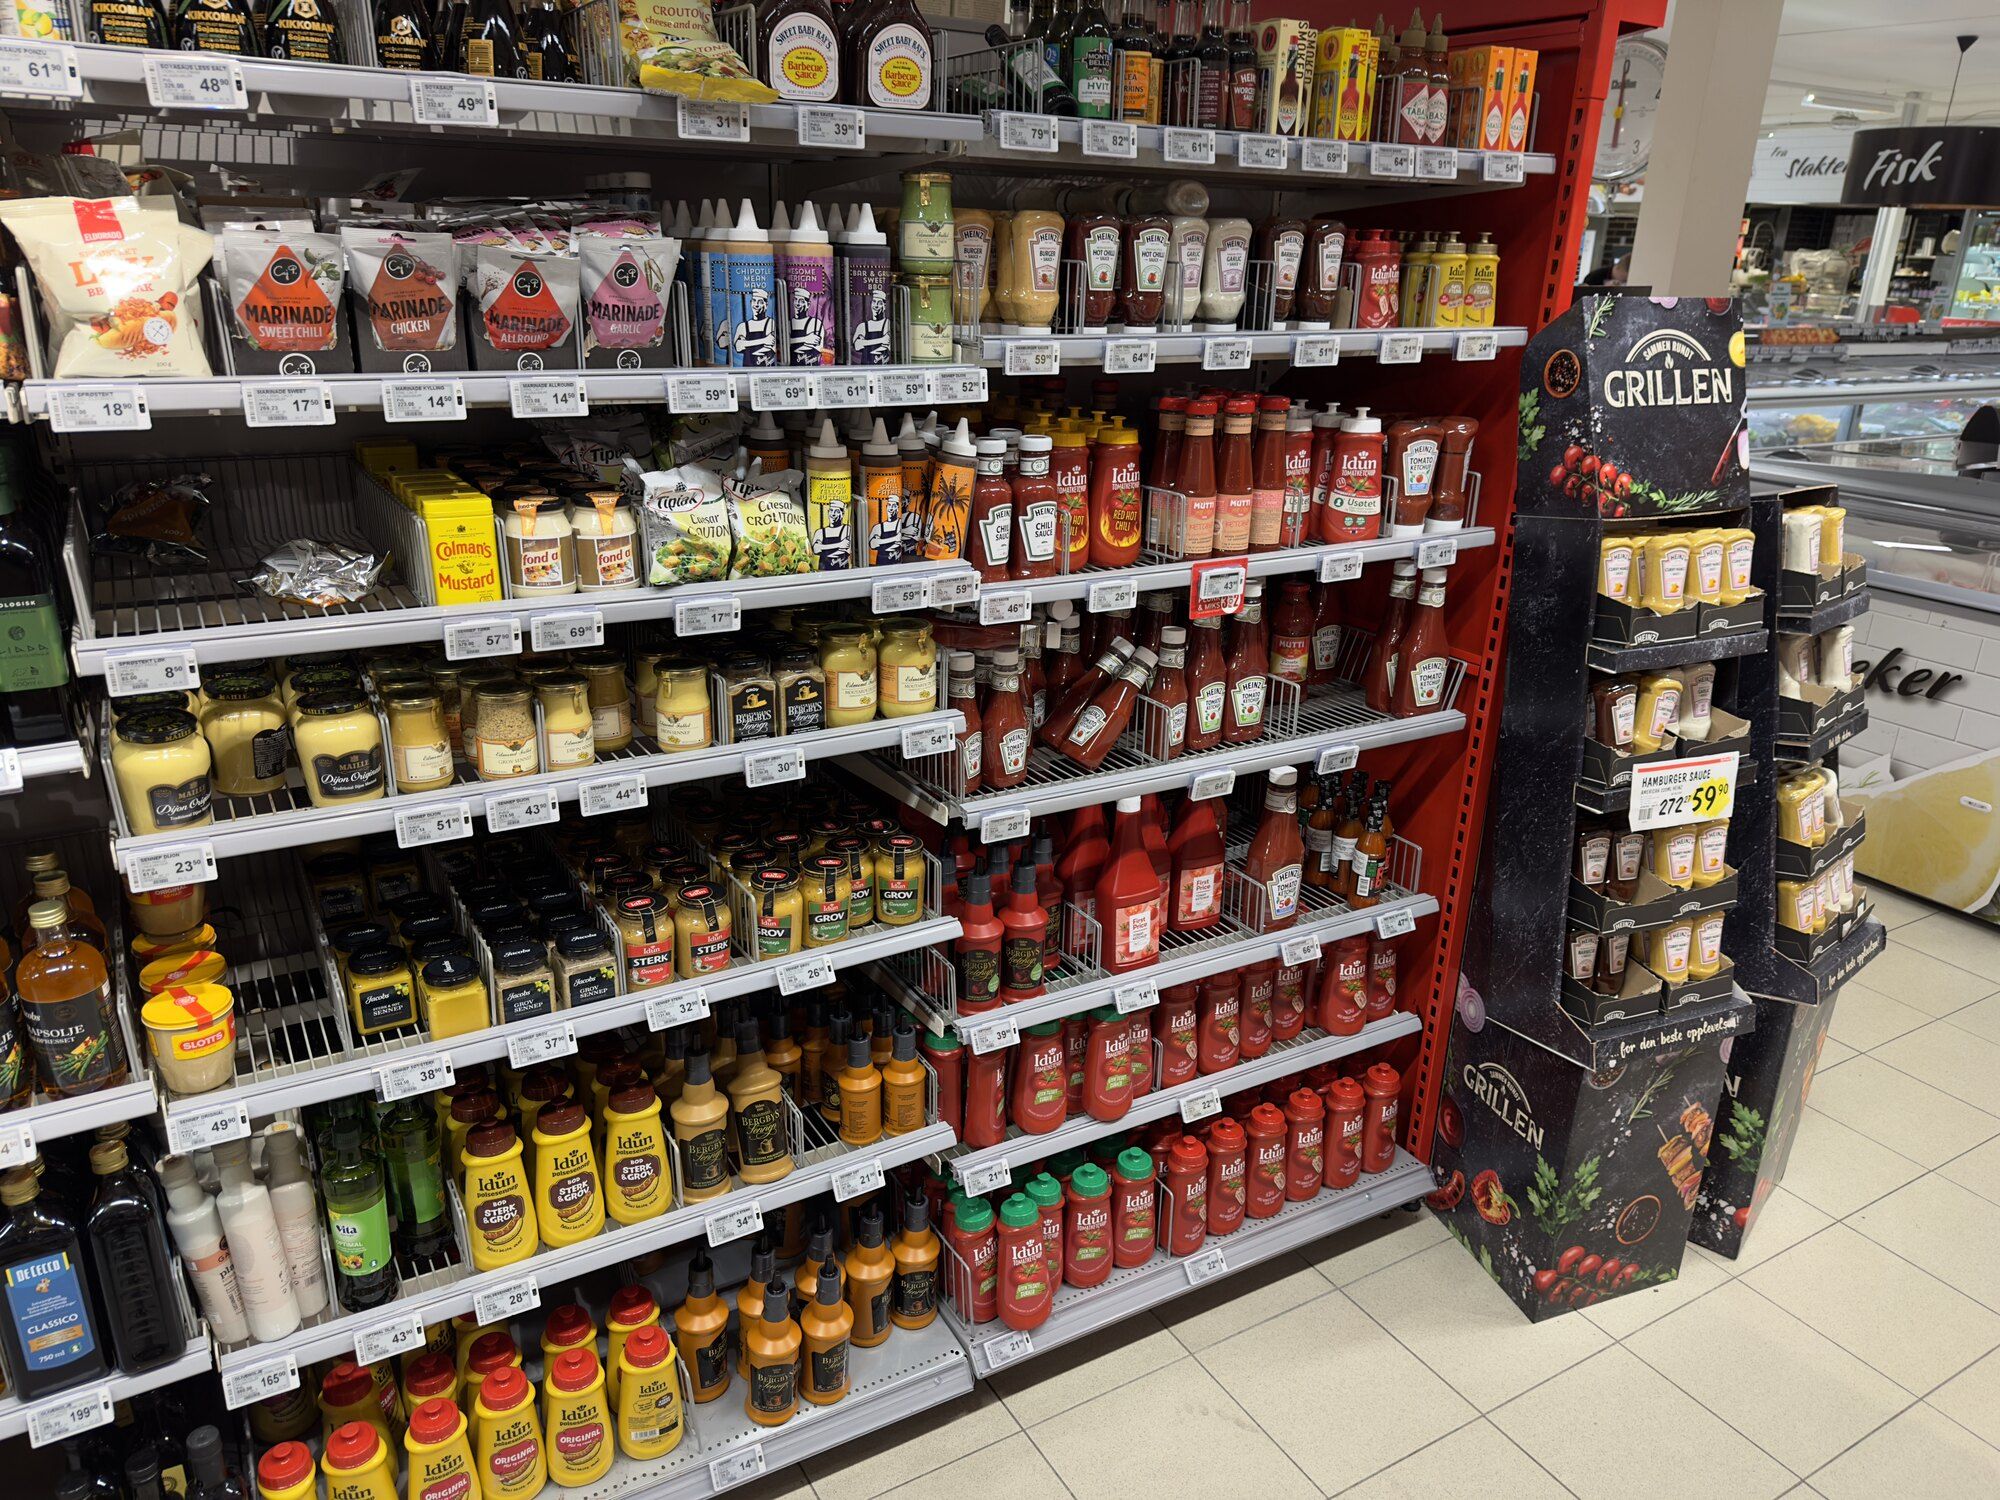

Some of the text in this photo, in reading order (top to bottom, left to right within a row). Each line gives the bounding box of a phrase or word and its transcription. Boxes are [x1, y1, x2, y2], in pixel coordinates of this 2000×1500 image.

[93, 3, 153, 17] KIKKOMAN
[188, 11, 245, 24] KIKKOMAN
[673, 20, 687, 29] and
[278, 18, 335, 34] KIKKOMAN
[379, 36, 427, 47] KIKKOMAN
[775, 30, 797, 45] SWEET
[797, 24, 815, 35] BABY
[875, 39, 893, 55] SWEET
[894, 36, 913, 45] BABY
[788, 62, 823, 73] Barbecue
[795, 71, 817, 80] Sauce
[885, 72, 918, 82] Barbecue
[891, 80, 912, 88] Sauce
[1087, 81, 1109, 90] HVIT
[1771, 147, 1788, 158] Fra
[1863, 141, 1944, 191] Fisk
[83, 231, 123, 241] ELDORADO
[245, 303, 333, 325] MARINADE
[373, 297, 447, 321] MARINADE
[591, 302, 660, 322] MARINADE
[258, 321, 294, 338] SWEET
[391, 320, 431, 334] CHICKEN
[488, 312, 563, 333] MARINADE
[610, 324, 641, 334] GARLIC
[500, 333, 548, 344] ALLROUND
[1644, 340, 1694, 360] SAMMEN RUNDT
[1604, 368, 1733, 408] GRILLEN
[1342, 451, 1376, 469] Idun
[1409, 456, 1433, 465] TOMATO
[1112, 462, 1140, 484] Idun
[1342, 468, 1376, 476] TOMATKETCHUP
[656, 492, 697, 508] Tipiak
[1230, 499, 1251, 507] MUTTI
[1348, 499, 1376, 508] Usøtet
[747, 514, 806, 526] CROUTONS
[1113, 510, 1137, 520] RED HOT
[1035, 522, 1053, 531] CHILI
[1035, 529, 1053, 537] SAUCE
[1115, 521, 1131, 531] CHILI
[435, 541, 492, 561] Colman's
[522, 553, 548, 565] fond
[598, 552, 621, 566] fond
[438, 571, 495, 591] Mustard
[1205, 601, 1221, 610] MIKS
[1279, 640, 1305, 648] MUTTI
[1422, 662, 1442, 672] HEINZ
[1419, 672, 1443, 682] TOMATO
[1242, 682, 1262, 691] HEINZ
[788, 701, 822, 717] BERGBYS
[736, 710, 772, 724] BERGBYS
[340, 761, 369, 772] MAILLE
[1642, 769, 1711, 787] HAMBURGER SAUCE
[1277, 881, 1297, 891] TOMATO
[884, 891, 913, 899] GROV
[815, 912, 845, 922] GROV
[1132, 917, 1146, 925] First
[1132, 922, 1147, 930] Price
[571, 933, 597, 941] Jacobs
[504, 948, 531, 958] Jacobs
[697, 941, 728, 954] STERK
[632, 953, 668, 967] STERK
[1339, 960, 1366, 976] Idun
[573, 976, 597, 988] Jacobs
[364, 993, 390, 1004] Jacobs
[506, 990, 531, 1001] Jacobs
[513, 999, 533, 1008] GROV
[373, 1005, 404, 1017] SENNEP
[1640, 1039, 1656, 1050] den
[1660, 1029, 1683, 1045] beste
[1687, 1016, 1740, 1042] opplevelsen!
[180, 1032, 223, 1051] SLOTTS
[1034, 1048, 1062, 1067] Idun
[1464, 1064, 1545, 1151] GRILLEN
[742, 1109, 780, 1127] BERGBYS
[1342, 1116, 1363, 1133] Idun
[617, 1131, 653, 1150] Idun
[1298, 1128, 1323, 1144] Idun
[688, 1136, 726, 1155] BERGBYS
[1259, 1144, 1285, 1161] Idun
[553, 1149, 588, 1171] Idun
[622, 1164, 652, 1176] STERK
[479, 1172, 516, 1192] Idun
[558, 1181, 589, 1196] STERK
[484, 1204, 516, 1218] STERK
[1077, 1210, 1107, 1225] Idun
[336, 1224, 357, 1235] Vita
[27, 1313, 78, 1334] CLASSICO
[38, 1350, 65, 1363] 750 ml
[562, 1404, 597, 1421] Idun
[495, 1421, 532, 1441] Idun
[560, 1429, 601, 1445] ORIGINAL
[495, 1444, 535, 1466] ORIGINAL
[425, 1454, 463, 1477] Idun
[425, 1479, 467, 1500] ORIGINAL
